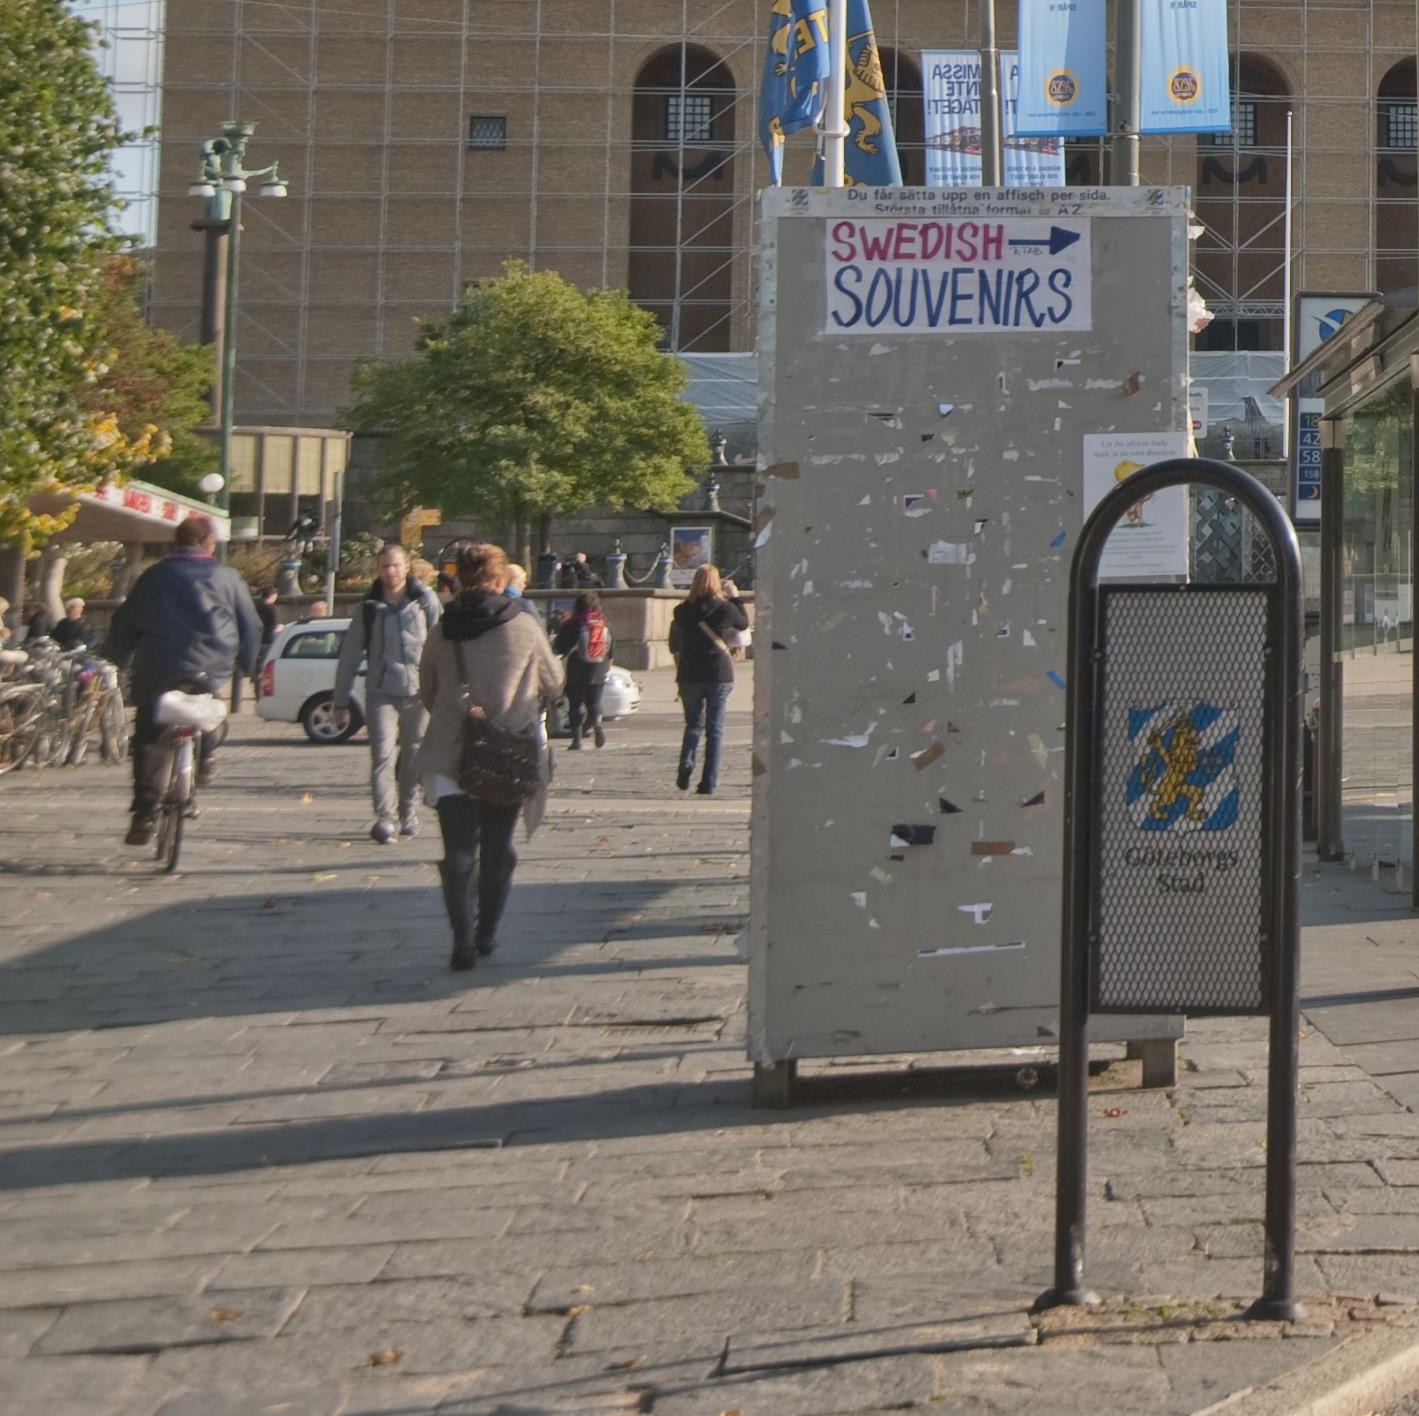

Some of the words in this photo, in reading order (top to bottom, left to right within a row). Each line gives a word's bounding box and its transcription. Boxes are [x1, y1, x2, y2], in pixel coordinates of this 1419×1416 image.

[847, 189, 867, 200] Du
[874, 188, 893, 200] får
[899, 189, 935, 200] sätta
[942, 190, 967, 202] upp
[974, 191, 991, 200] en
[997, 188, 1045, 200] affisch
[1051, 190, 1073, 202] per
[1079, 188, 1110, 200] sida.
[831, 220, 1004, 262] SWEDISH
[831, 264, 1074, 328] SOUVENIRS
[1303, 432, 1320, 446] 42
[1303, 450, 1321, 463] 58
[1124, 845, 1239, 872] Göteborgs
[1156, 872, 1204, 894] Stad
